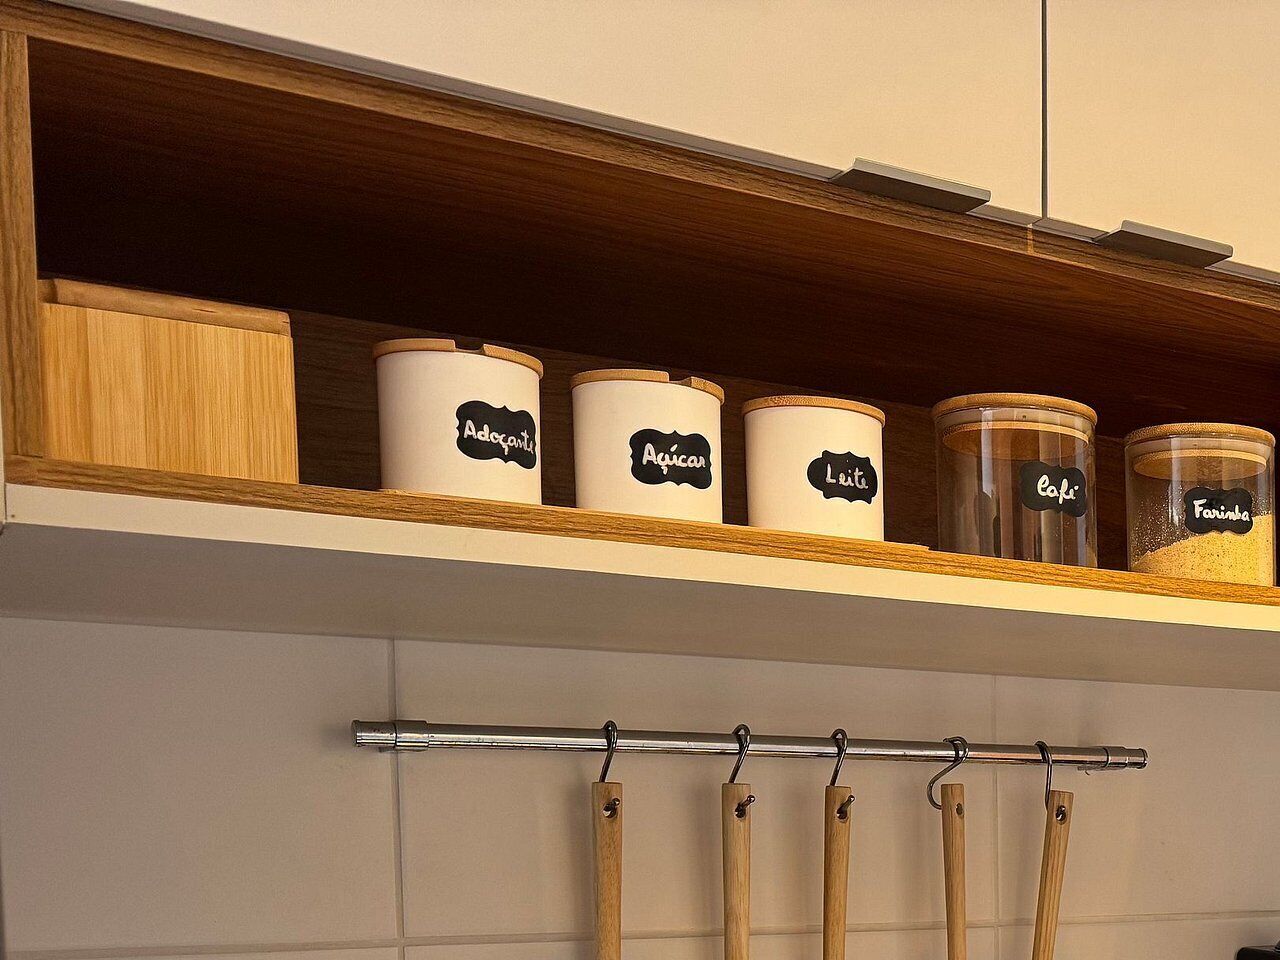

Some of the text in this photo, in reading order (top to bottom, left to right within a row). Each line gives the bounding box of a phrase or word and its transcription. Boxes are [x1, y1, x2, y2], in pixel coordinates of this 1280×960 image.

[463, 419, 534, 455] Adoçante
[642, 442, 706, 475] Açúcar
[825, 463, 869, 490] Leite
[1192, 498, 1251, 522] Farinha
